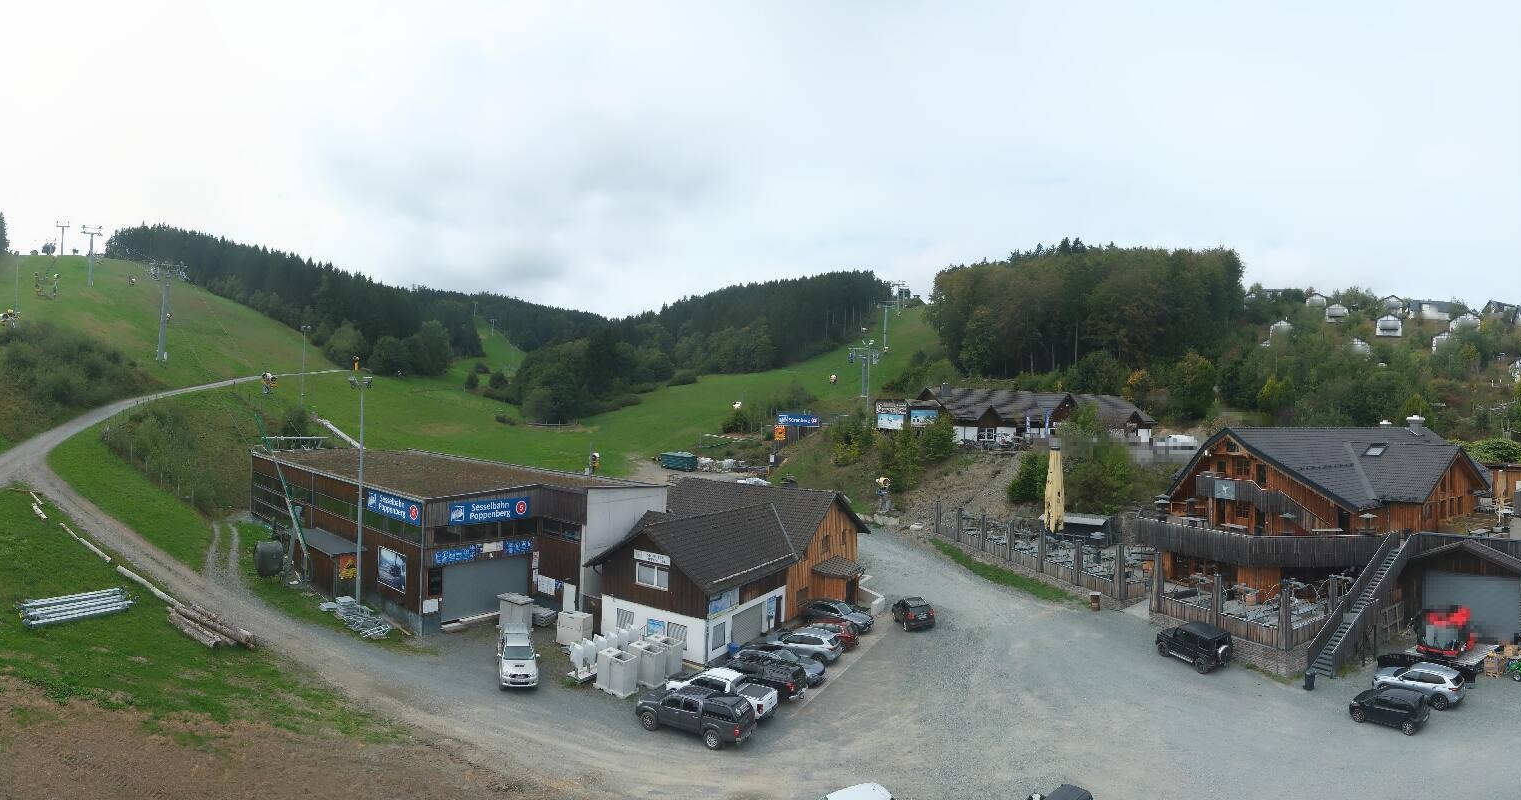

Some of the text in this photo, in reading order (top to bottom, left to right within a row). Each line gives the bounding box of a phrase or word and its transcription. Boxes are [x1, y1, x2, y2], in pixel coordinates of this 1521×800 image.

[379, 494, 405, 509] Sesselbahn
[471, 500, 510, 512] Sesselbahn
[378, 502, 406, 519] Poppenberg
[469, 509, 511, 521] Poppenberg
